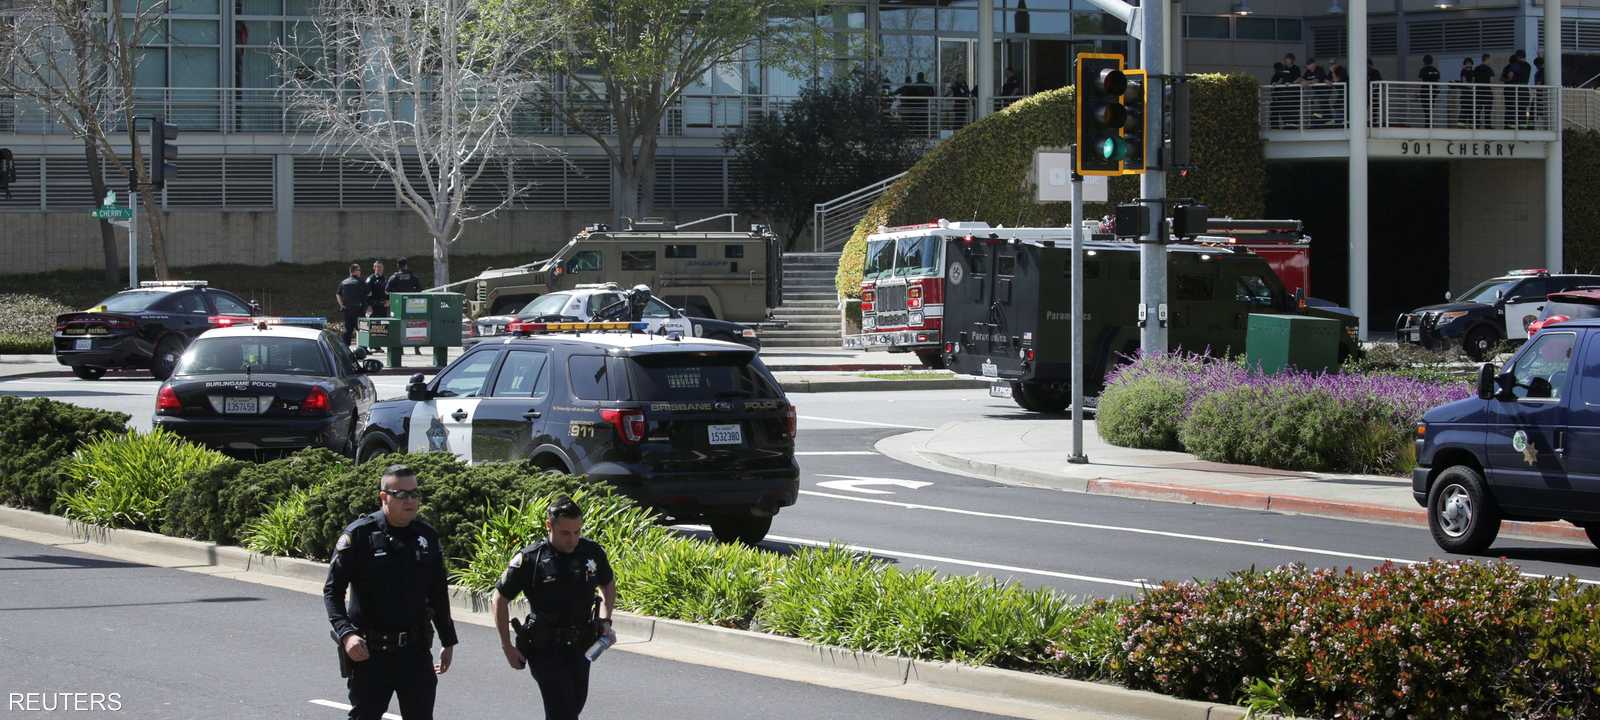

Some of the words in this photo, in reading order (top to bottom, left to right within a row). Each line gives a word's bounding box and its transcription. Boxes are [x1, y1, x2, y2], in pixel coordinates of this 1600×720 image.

[1401, 142, 1431, 155] 901
[1447, 142, 1515, 156] CHERRY
[99, 209, 122, 218] CHERRY
[1046, 310, 1093, 321] Paramcs
[651, 403, 711, 411] BRISBANE
[571, 425, 595, 438] 911
